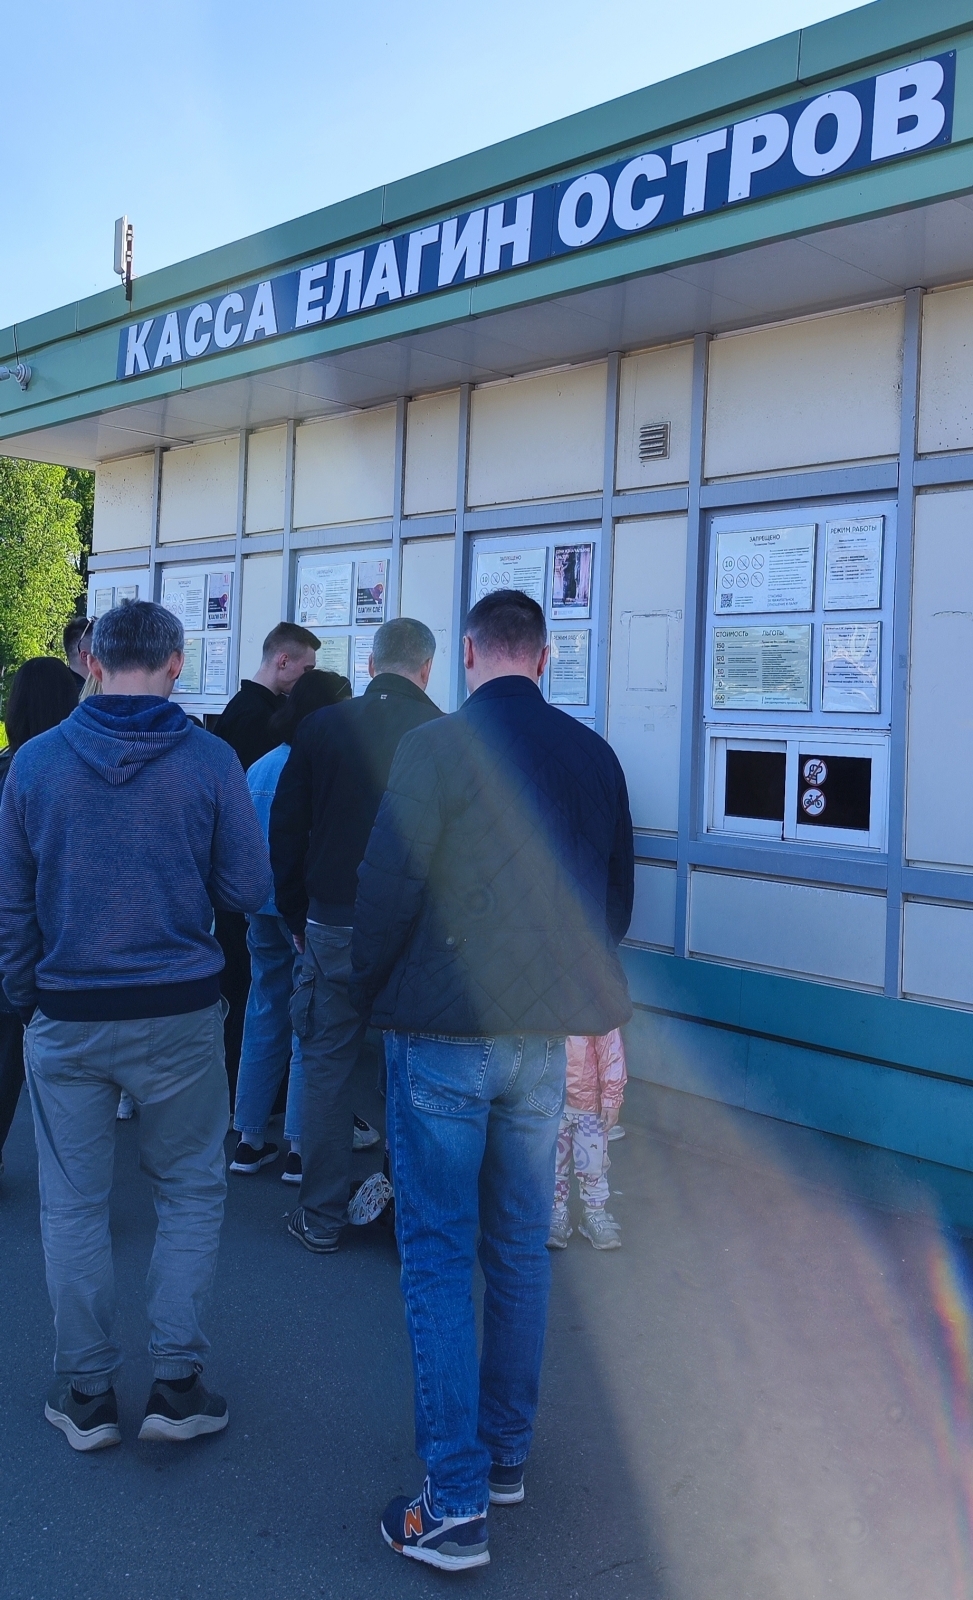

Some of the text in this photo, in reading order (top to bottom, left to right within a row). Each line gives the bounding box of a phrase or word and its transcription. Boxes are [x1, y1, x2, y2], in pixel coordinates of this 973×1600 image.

[124, 59, 946, 376] КАССА ЕЛАГИН ОСТРОВ
[830, 525, 877, 534] РЕЖИМ РАБОТЫ
[749, 533, 781, 542] ЗАПРЕЩЕНО
[761, 629, 785, 637] ЛЬГОТЫ
[404, 1505, 423, 1539] N
